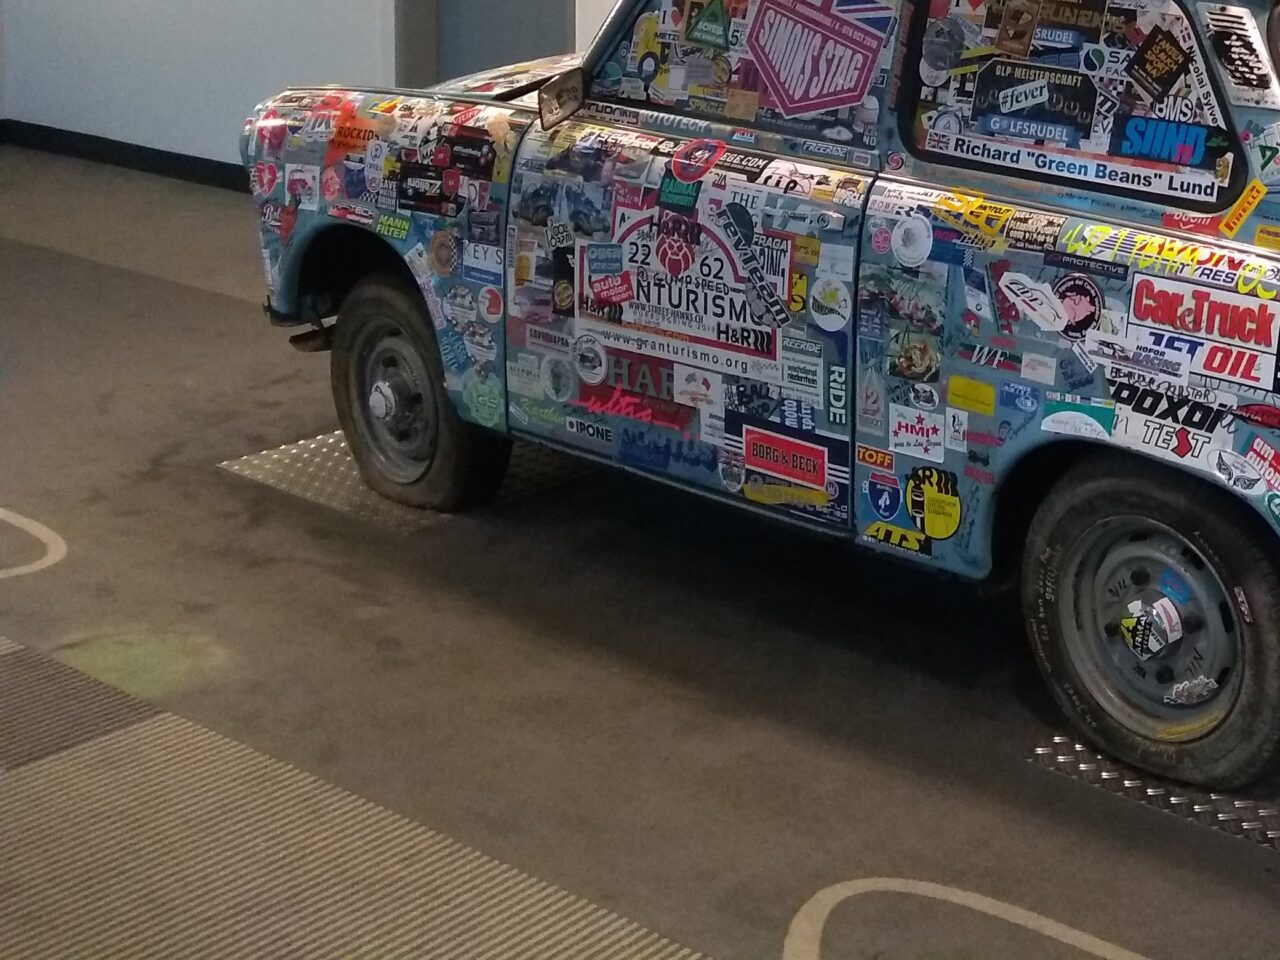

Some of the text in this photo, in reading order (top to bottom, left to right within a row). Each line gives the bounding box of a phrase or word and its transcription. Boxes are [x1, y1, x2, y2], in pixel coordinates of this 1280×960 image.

[953, 137, 1216, 199] Richard "Green Beans" Lund
[376, 225, 408, 240] FILTER
[379, 214, 410, 230] MANN
[628, 241, 651, 266] 22
[1062, 256, 1125, 274] PROTECTIVE
[700, 254, 724, 281] 62
[592, 274, 622, 293] auto
[600, 284, 629, 300] motor
[601, 330, 749, 373] www.granturismo.org
[1135, 344, 1167, 358] HOFOR
[1202, 345, 1261, 383] OIL
[576, 419, 612, 443] IPONE
[896, 421, 931, 438] HMI
[1142, 420, 1212, 459] TEST
[752, 442, 779, 463] BORG
[791, 453, 819, 475] BECK
[857, 445, 893, 468] TOFF
[1252, 436, 1275, 460] am
[864, 520, 926, 551] ATS
